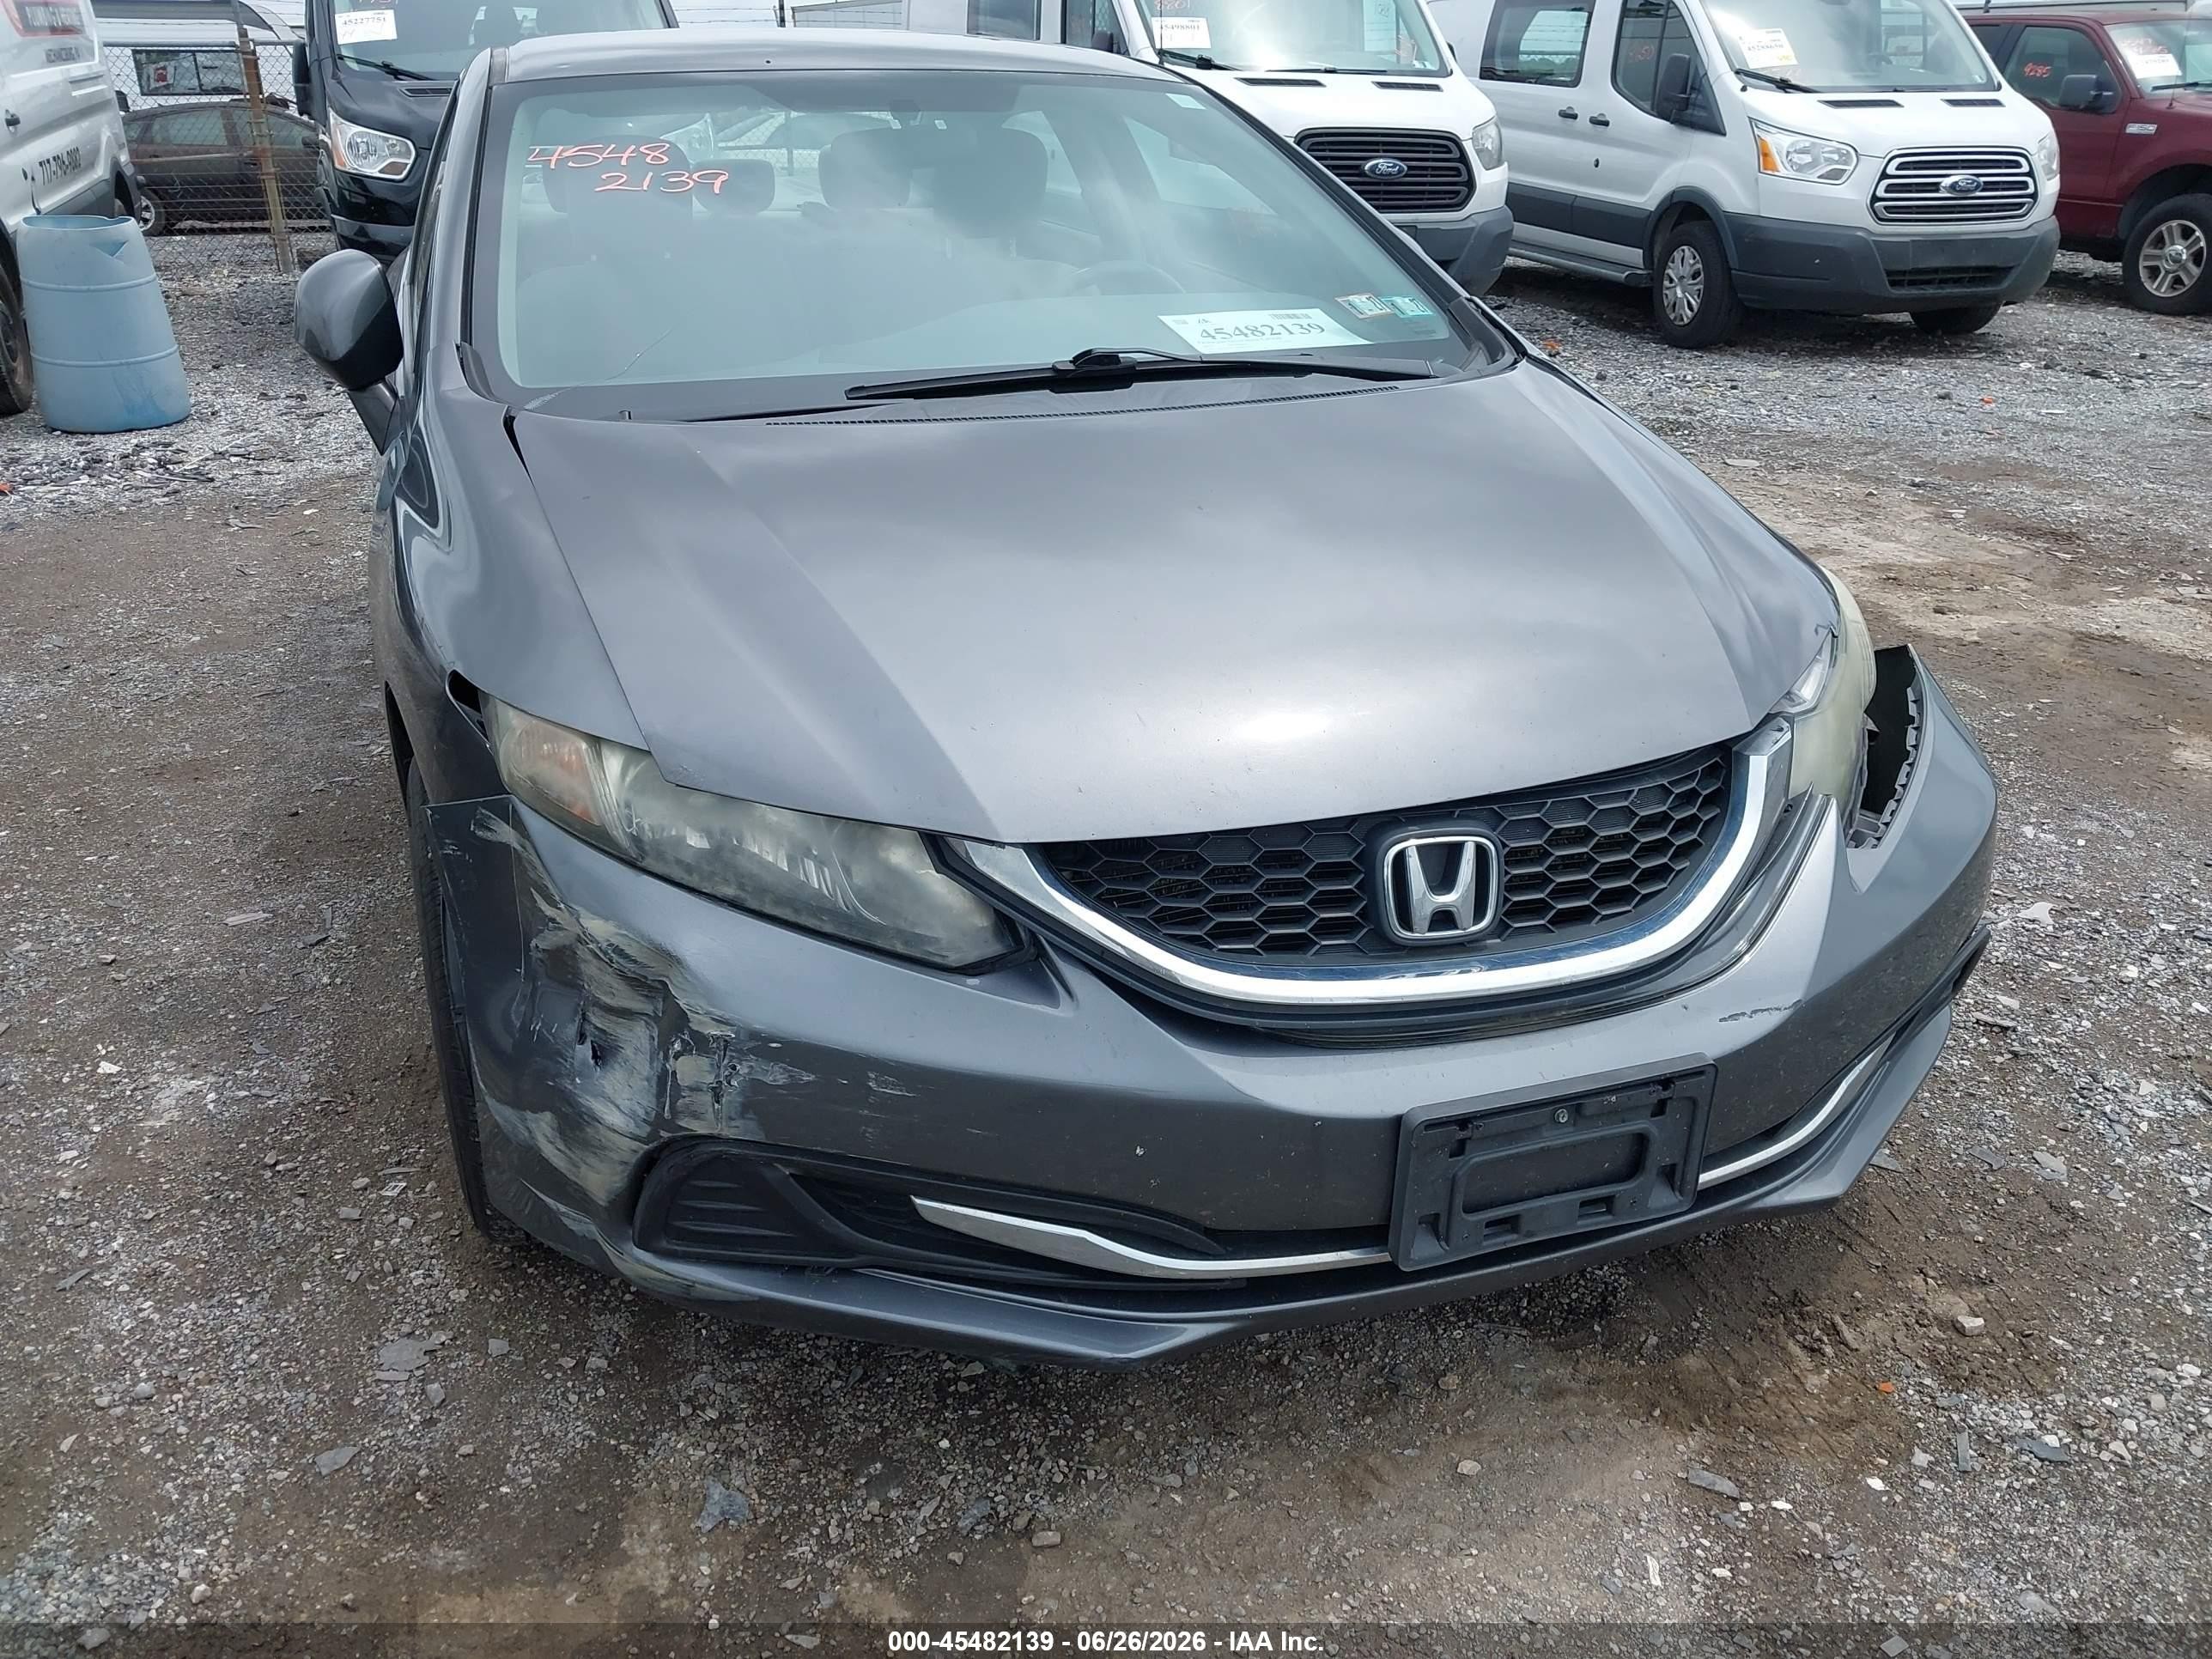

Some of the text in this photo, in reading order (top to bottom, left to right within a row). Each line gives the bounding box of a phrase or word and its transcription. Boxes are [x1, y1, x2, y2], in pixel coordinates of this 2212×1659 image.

[528, 143, 671, 169] 4548
[1376, 162, 1400, 174] Ford
[594, 169, 729, 194] 2139
[1200, 321, 1325, 340] 45482139
